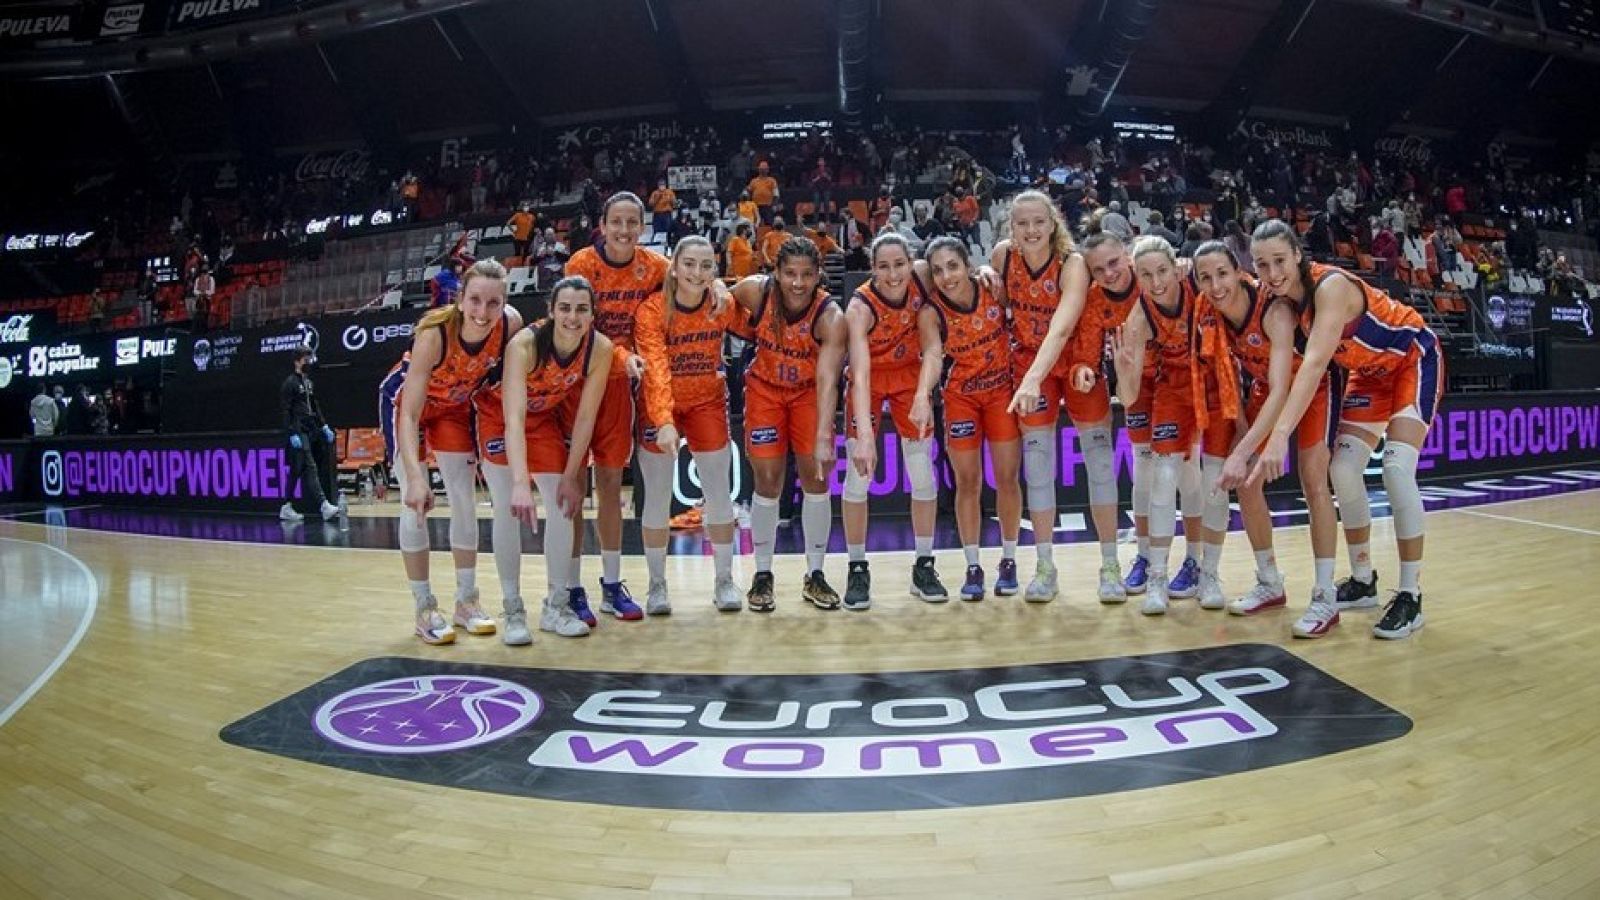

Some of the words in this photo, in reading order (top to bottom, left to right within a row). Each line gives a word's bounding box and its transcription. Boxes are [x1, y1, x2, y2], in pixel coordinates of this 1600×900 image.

[0, 15, 70, 36] PULEVA
[585, 120, 680, 145] CaBank
[48, 341, 81, 358] caixa
[48, 354, 100, 375] popular
[777, 363, 799, 383] 18
[572, 667, 1290, 729] EuroCup
[566, 712, 1258, 772] women
